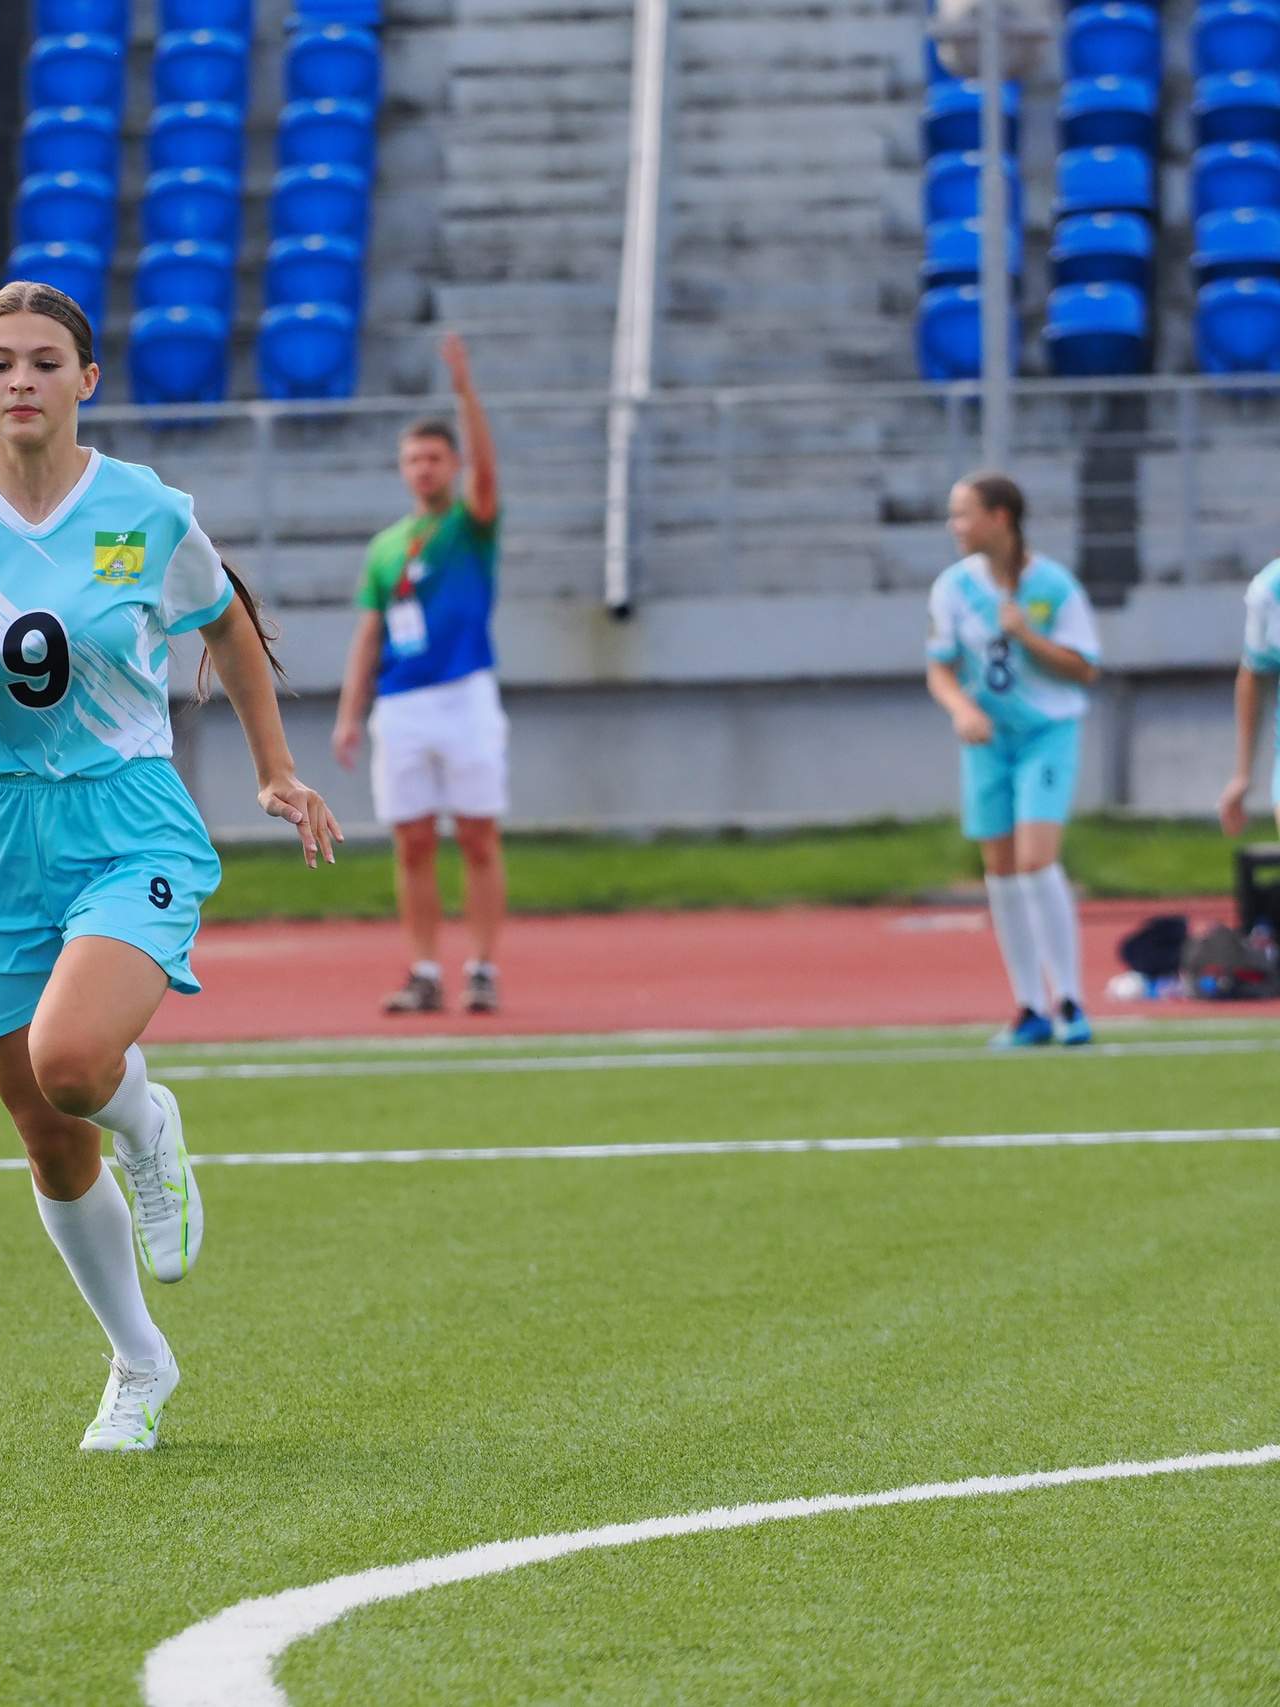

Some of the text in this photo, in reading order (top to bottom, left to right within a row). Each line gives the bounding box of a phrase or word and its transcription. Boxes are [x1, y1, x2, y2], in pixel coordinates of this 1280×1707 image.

[2, 611, 71, 708] 9
[986, 632, 1014, 693] 8
[148, 876, 173, 909] 9
